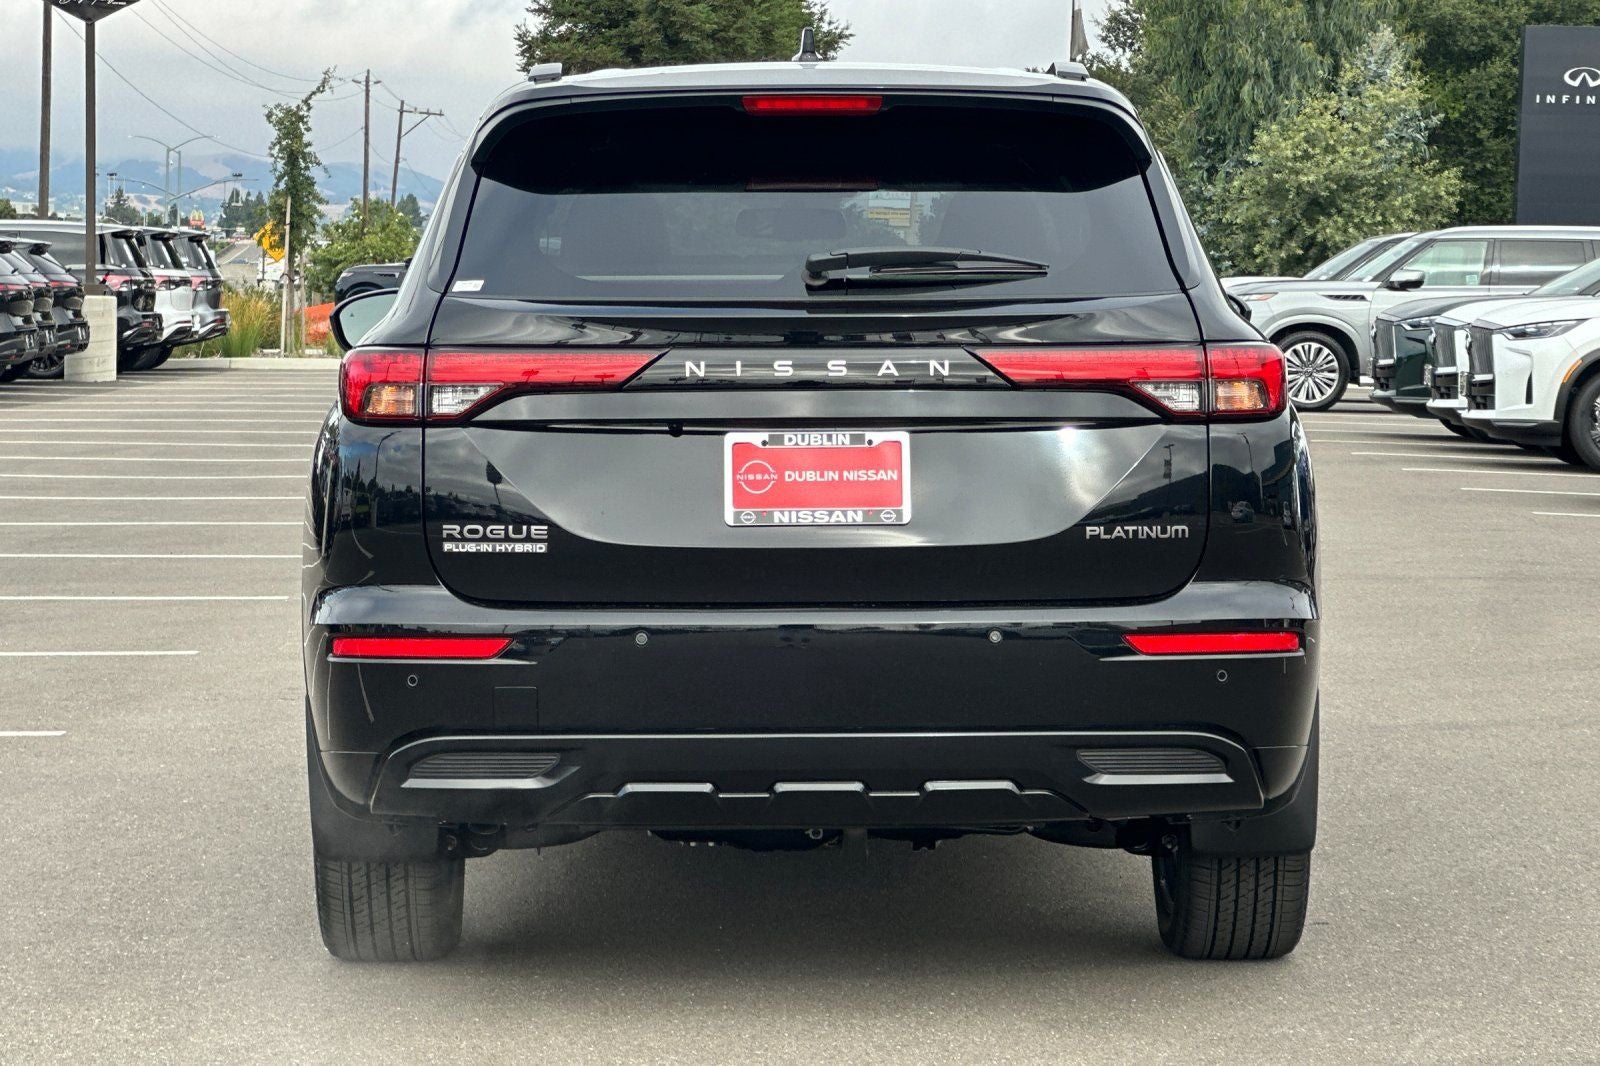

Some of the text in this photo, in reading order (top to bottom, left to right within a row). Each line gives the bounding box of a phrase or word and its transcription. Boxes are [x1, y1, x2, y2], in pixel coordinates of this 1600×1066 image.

[684, 360, 950, 378] NISSAN
[783, 433, 851, 446] DUBLIN
[736, 473, 778, 481] NISSAN
[784, 469, 898, 482] DUBLIN NISSAN
[773, 510, 864, 523] NISSAN
[442, 524, 549, 539] ROGUE
[1085, 525, 1189, 539] PLATINUM
[444, 543, 546, 553] PLUG-IN HYBRID
